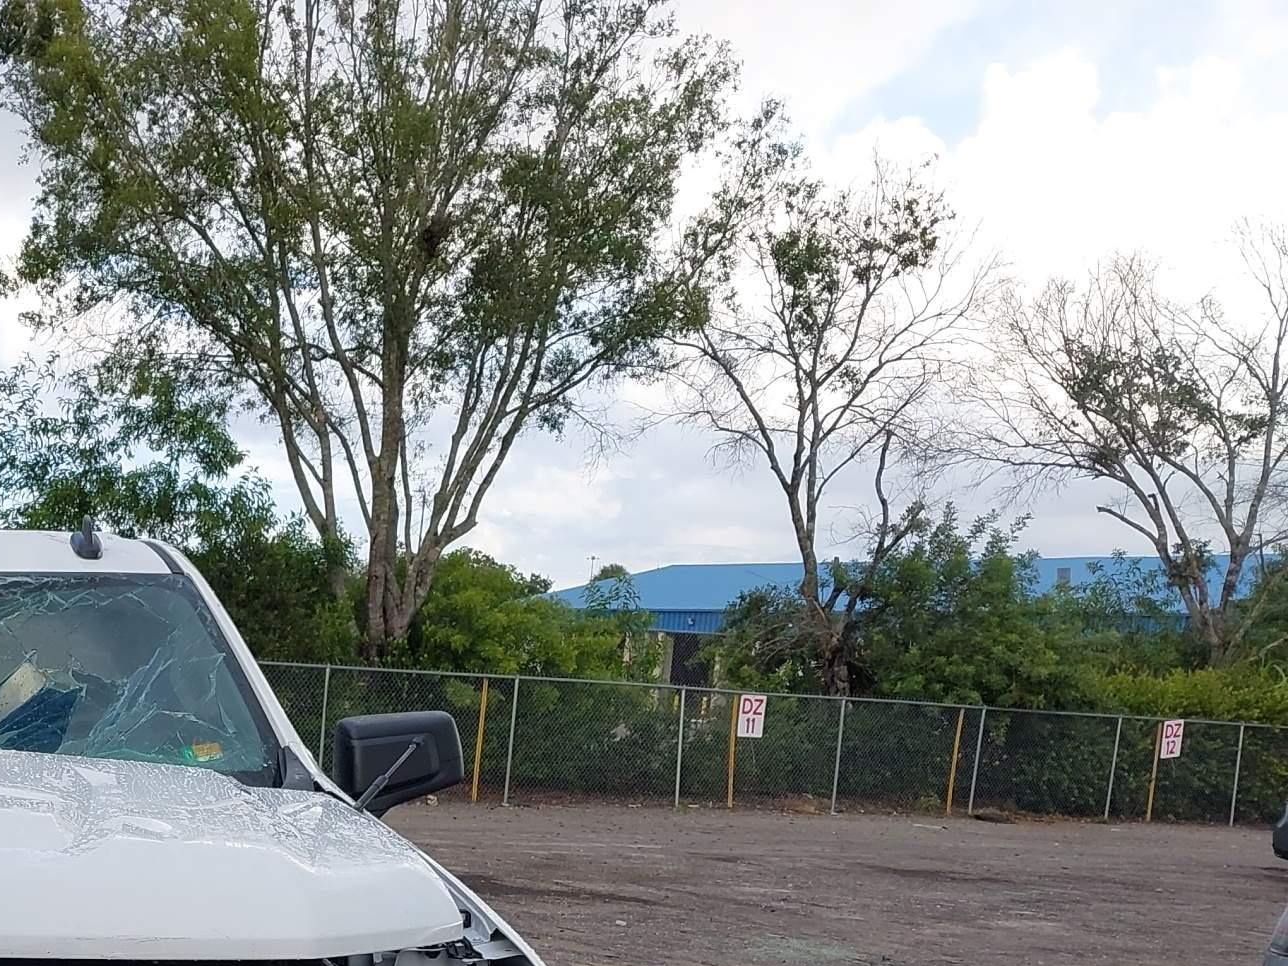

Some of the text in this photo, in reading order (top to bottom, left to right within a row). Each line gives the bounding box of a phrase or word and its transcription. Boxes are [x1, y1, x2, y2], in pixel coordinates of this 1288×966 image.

[742, 698, 764, 715] DZ
[746, 717, 755, 734] 11
[1165, 723, 1182, 739] DZ
[1166, 740, 1176, 755] 12
